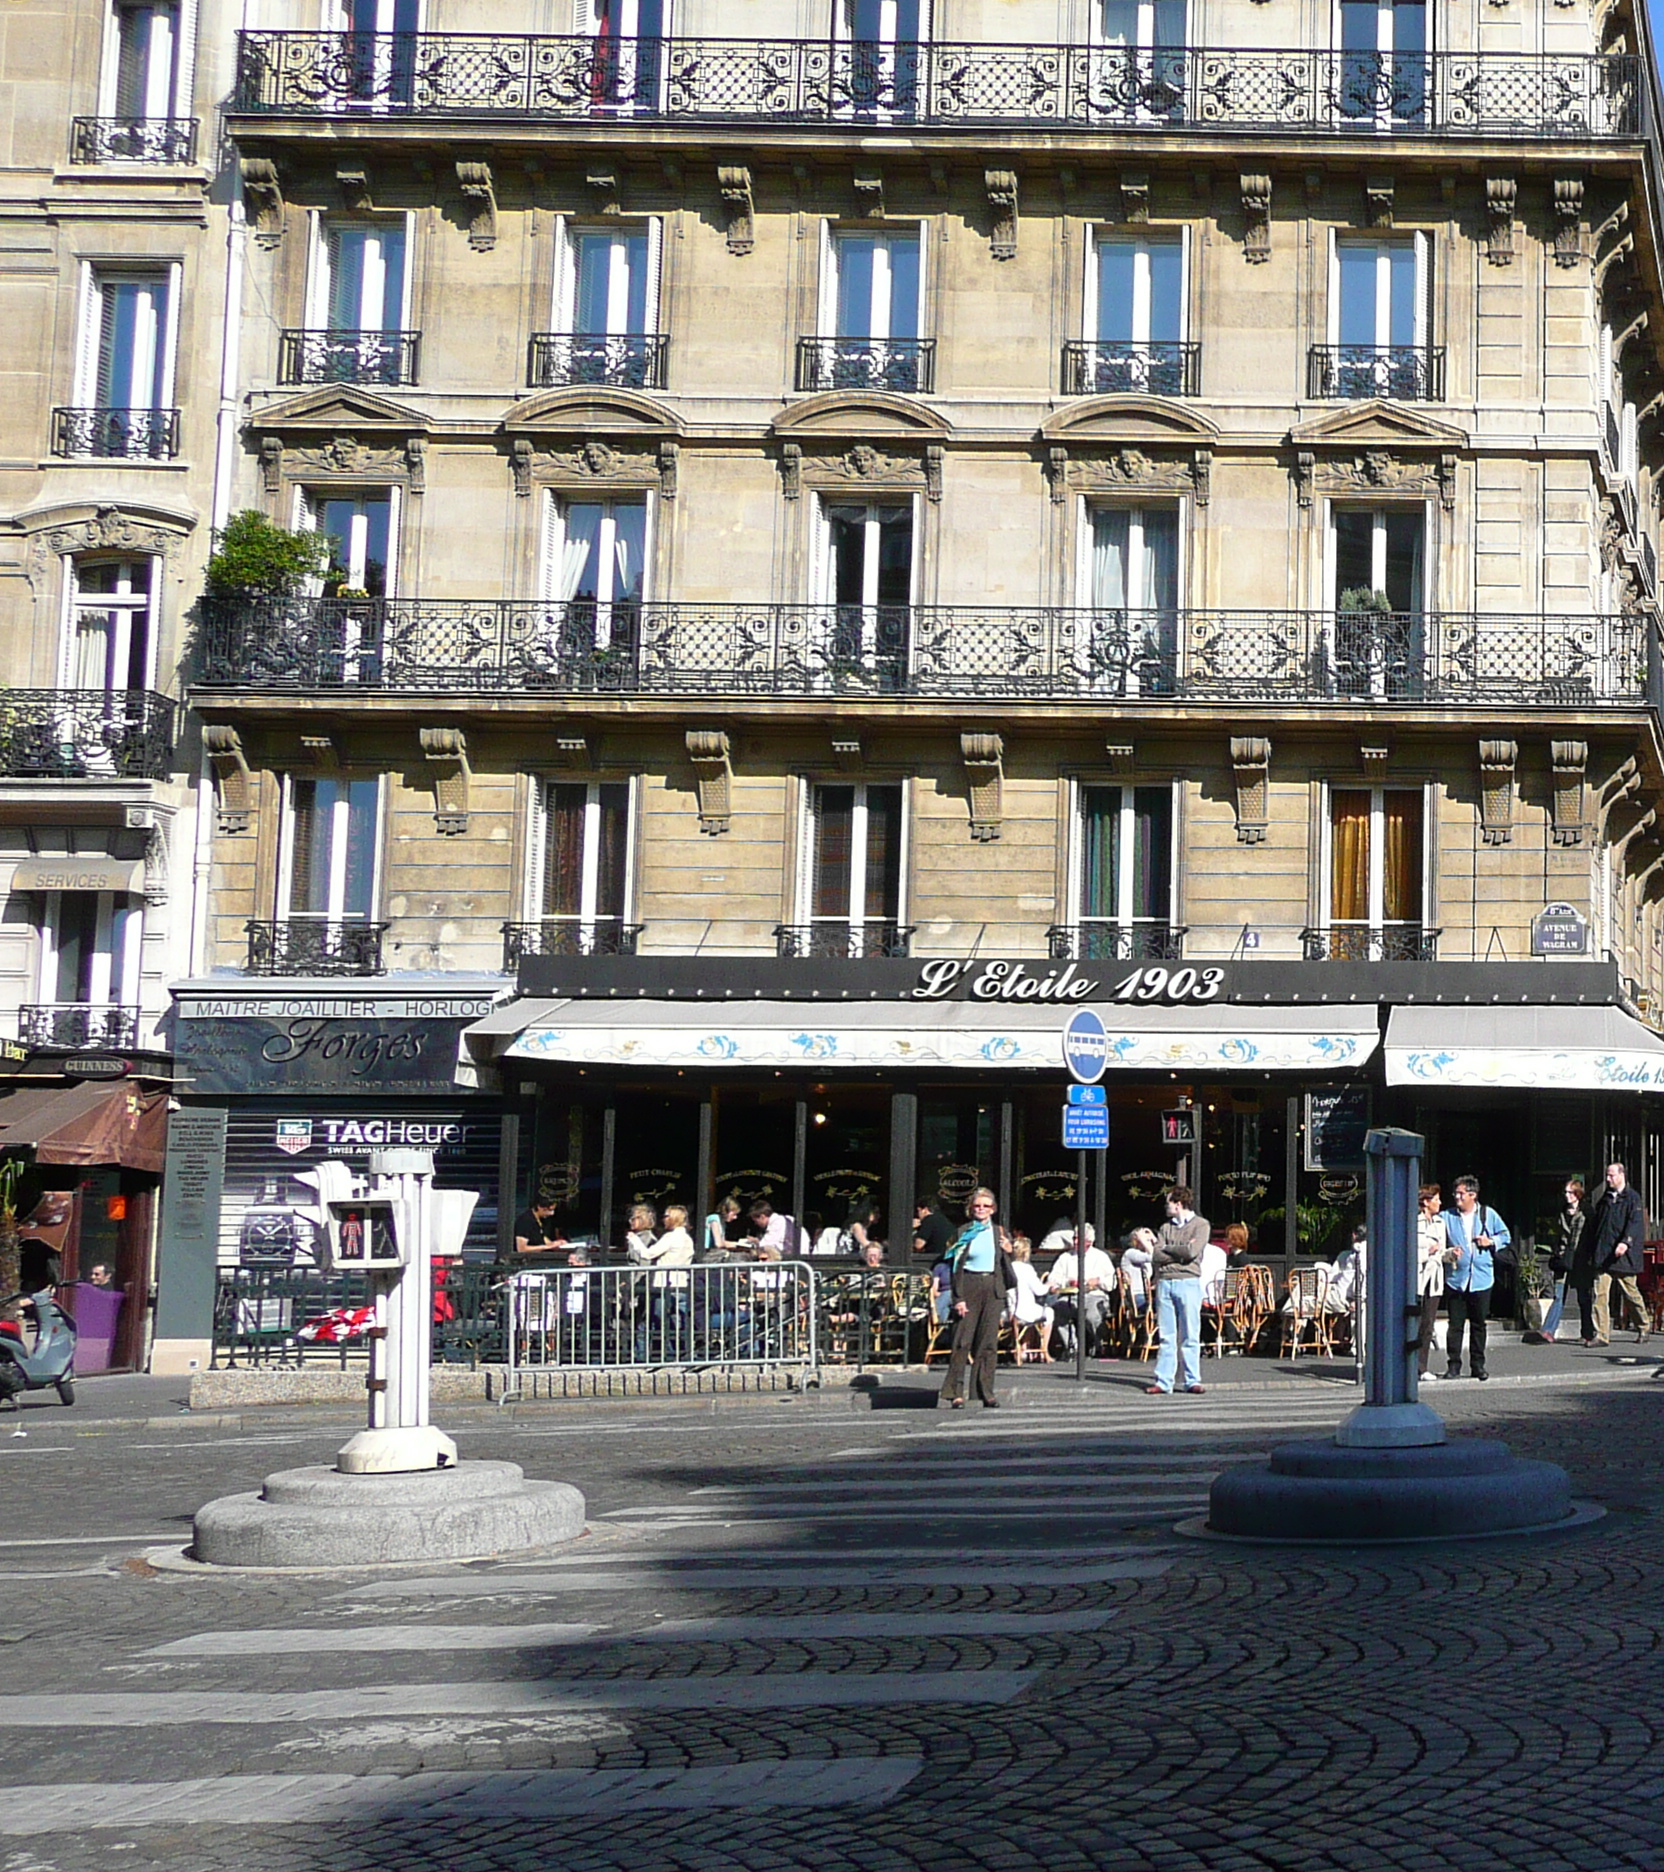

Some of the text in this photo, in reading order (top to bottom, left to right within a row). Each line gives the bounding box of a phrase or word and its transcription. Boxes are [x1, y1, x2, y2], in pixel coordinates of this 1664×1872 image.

[35, 873, 108, 888] SERVICES
[1543, 924, 1577, 932] AVENUE
[1246, 933, 1257, 947] 4
[1542, 941, 1578, 949] WAGRAM
[1114, 967, 1224, 999] 1903
[276, 1001, 376, 1016] JOAILLIER
[4, 1040, 29, 1061] Bar
[262, 1018, 428, 1075] Forges
[65, 1060, 124, 1071] GUINNESS
